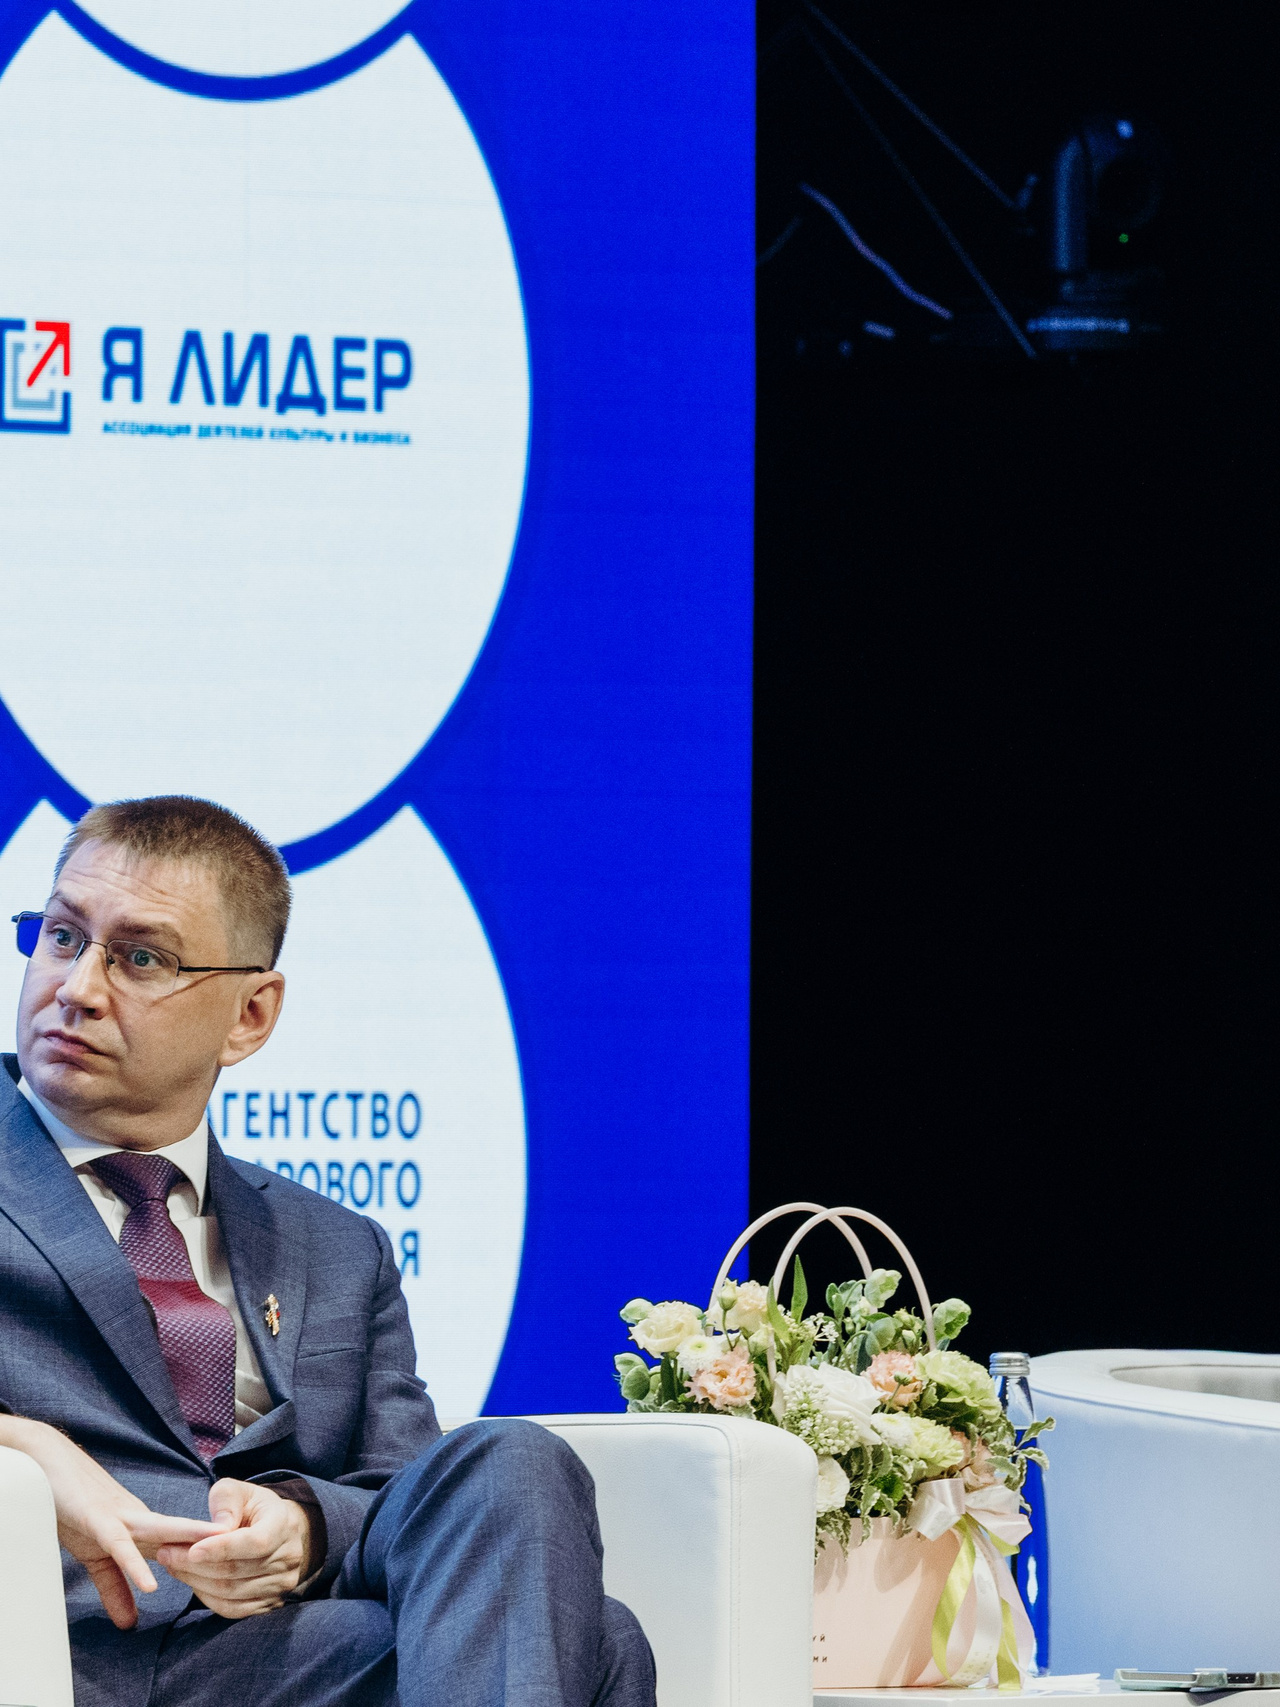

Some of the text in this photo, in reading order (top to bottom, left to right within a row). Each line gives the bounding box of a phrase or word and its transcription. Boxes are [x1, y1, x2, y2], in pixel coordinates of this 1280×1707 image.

[101, 325, 414, 418] Я ЛИДЕР
[399, 1230, 419, 1277] Я
